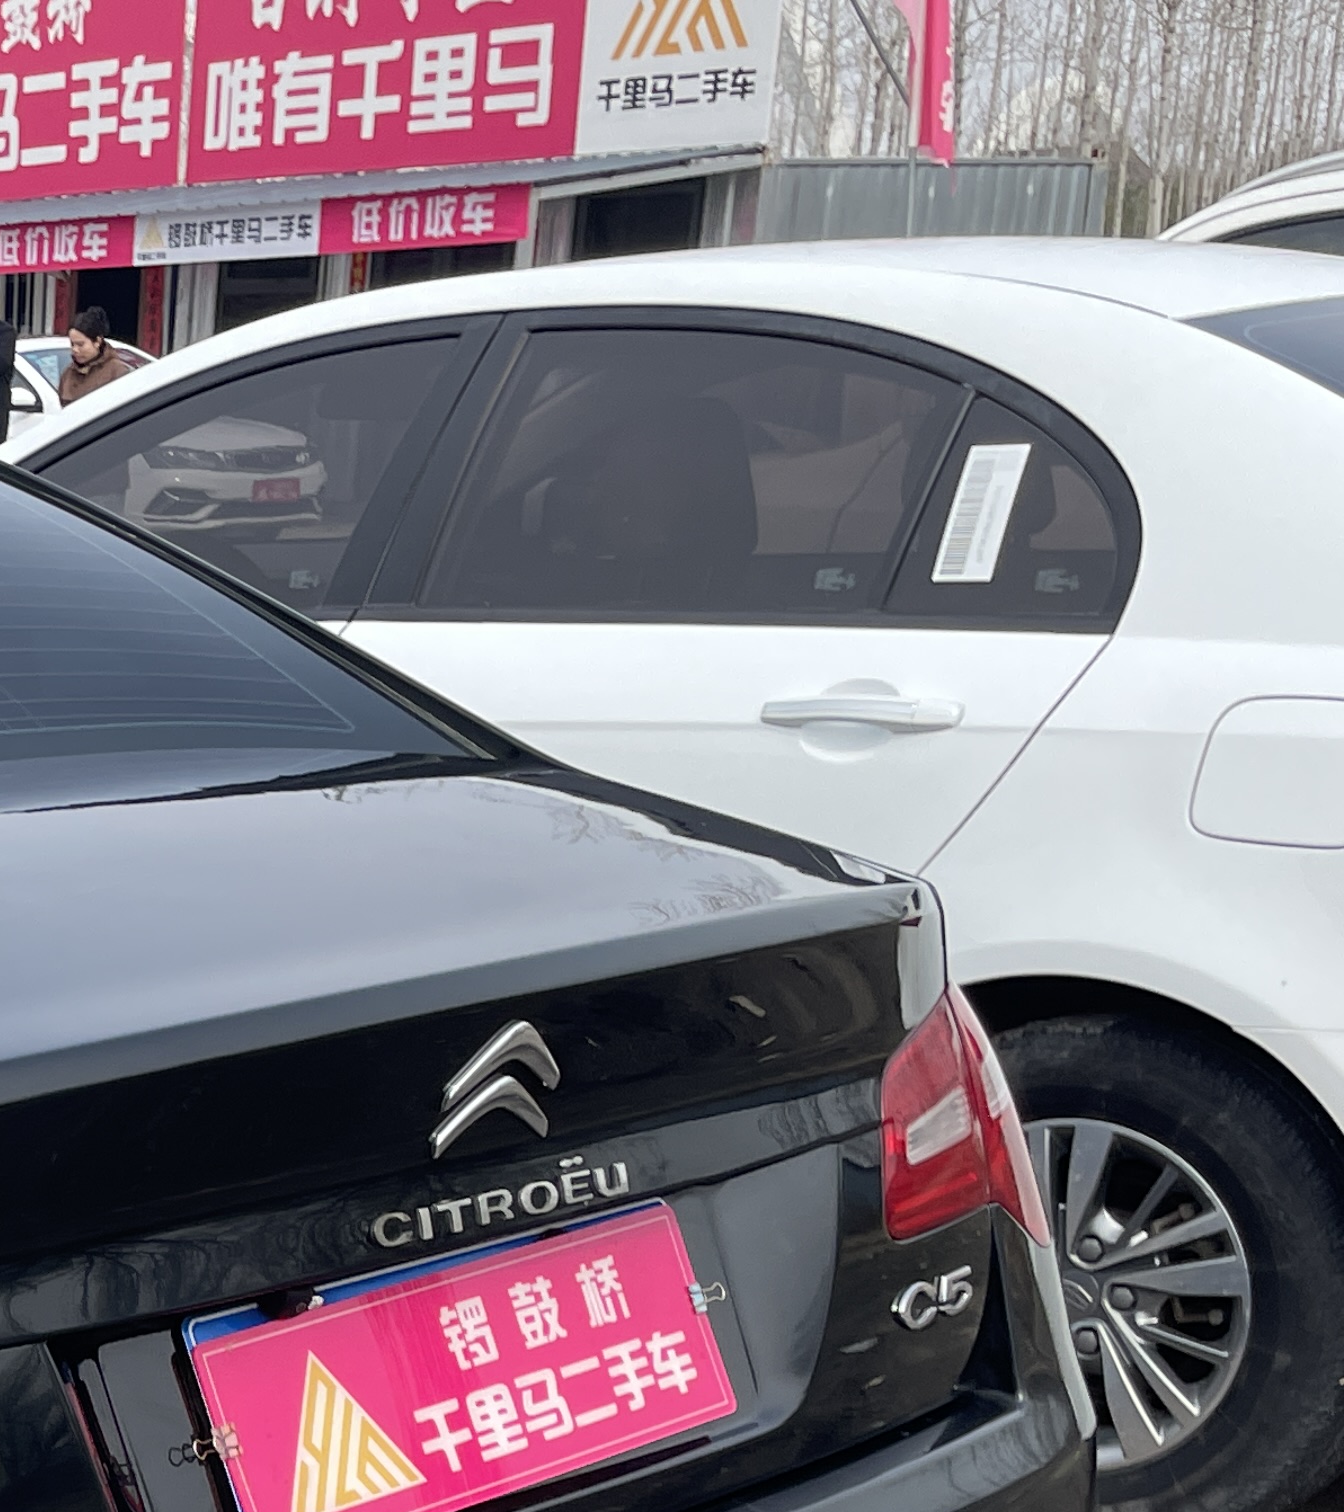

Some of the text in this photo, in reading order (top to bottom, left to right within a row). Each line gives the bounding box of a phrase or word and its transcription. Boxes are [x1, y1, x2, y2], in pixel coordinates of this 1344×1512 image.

[203, 23, 555, 151] 唯有千里马
[597, 67, 757, 112] 千里马二手车
[351, 192, 496, 244] 低价收车
[438, 1256, 631, 1372] 锣鼓桥
[890, 1265, 975, 1331] C5
[414, 1327, 700, 1475] 千里马二手车
